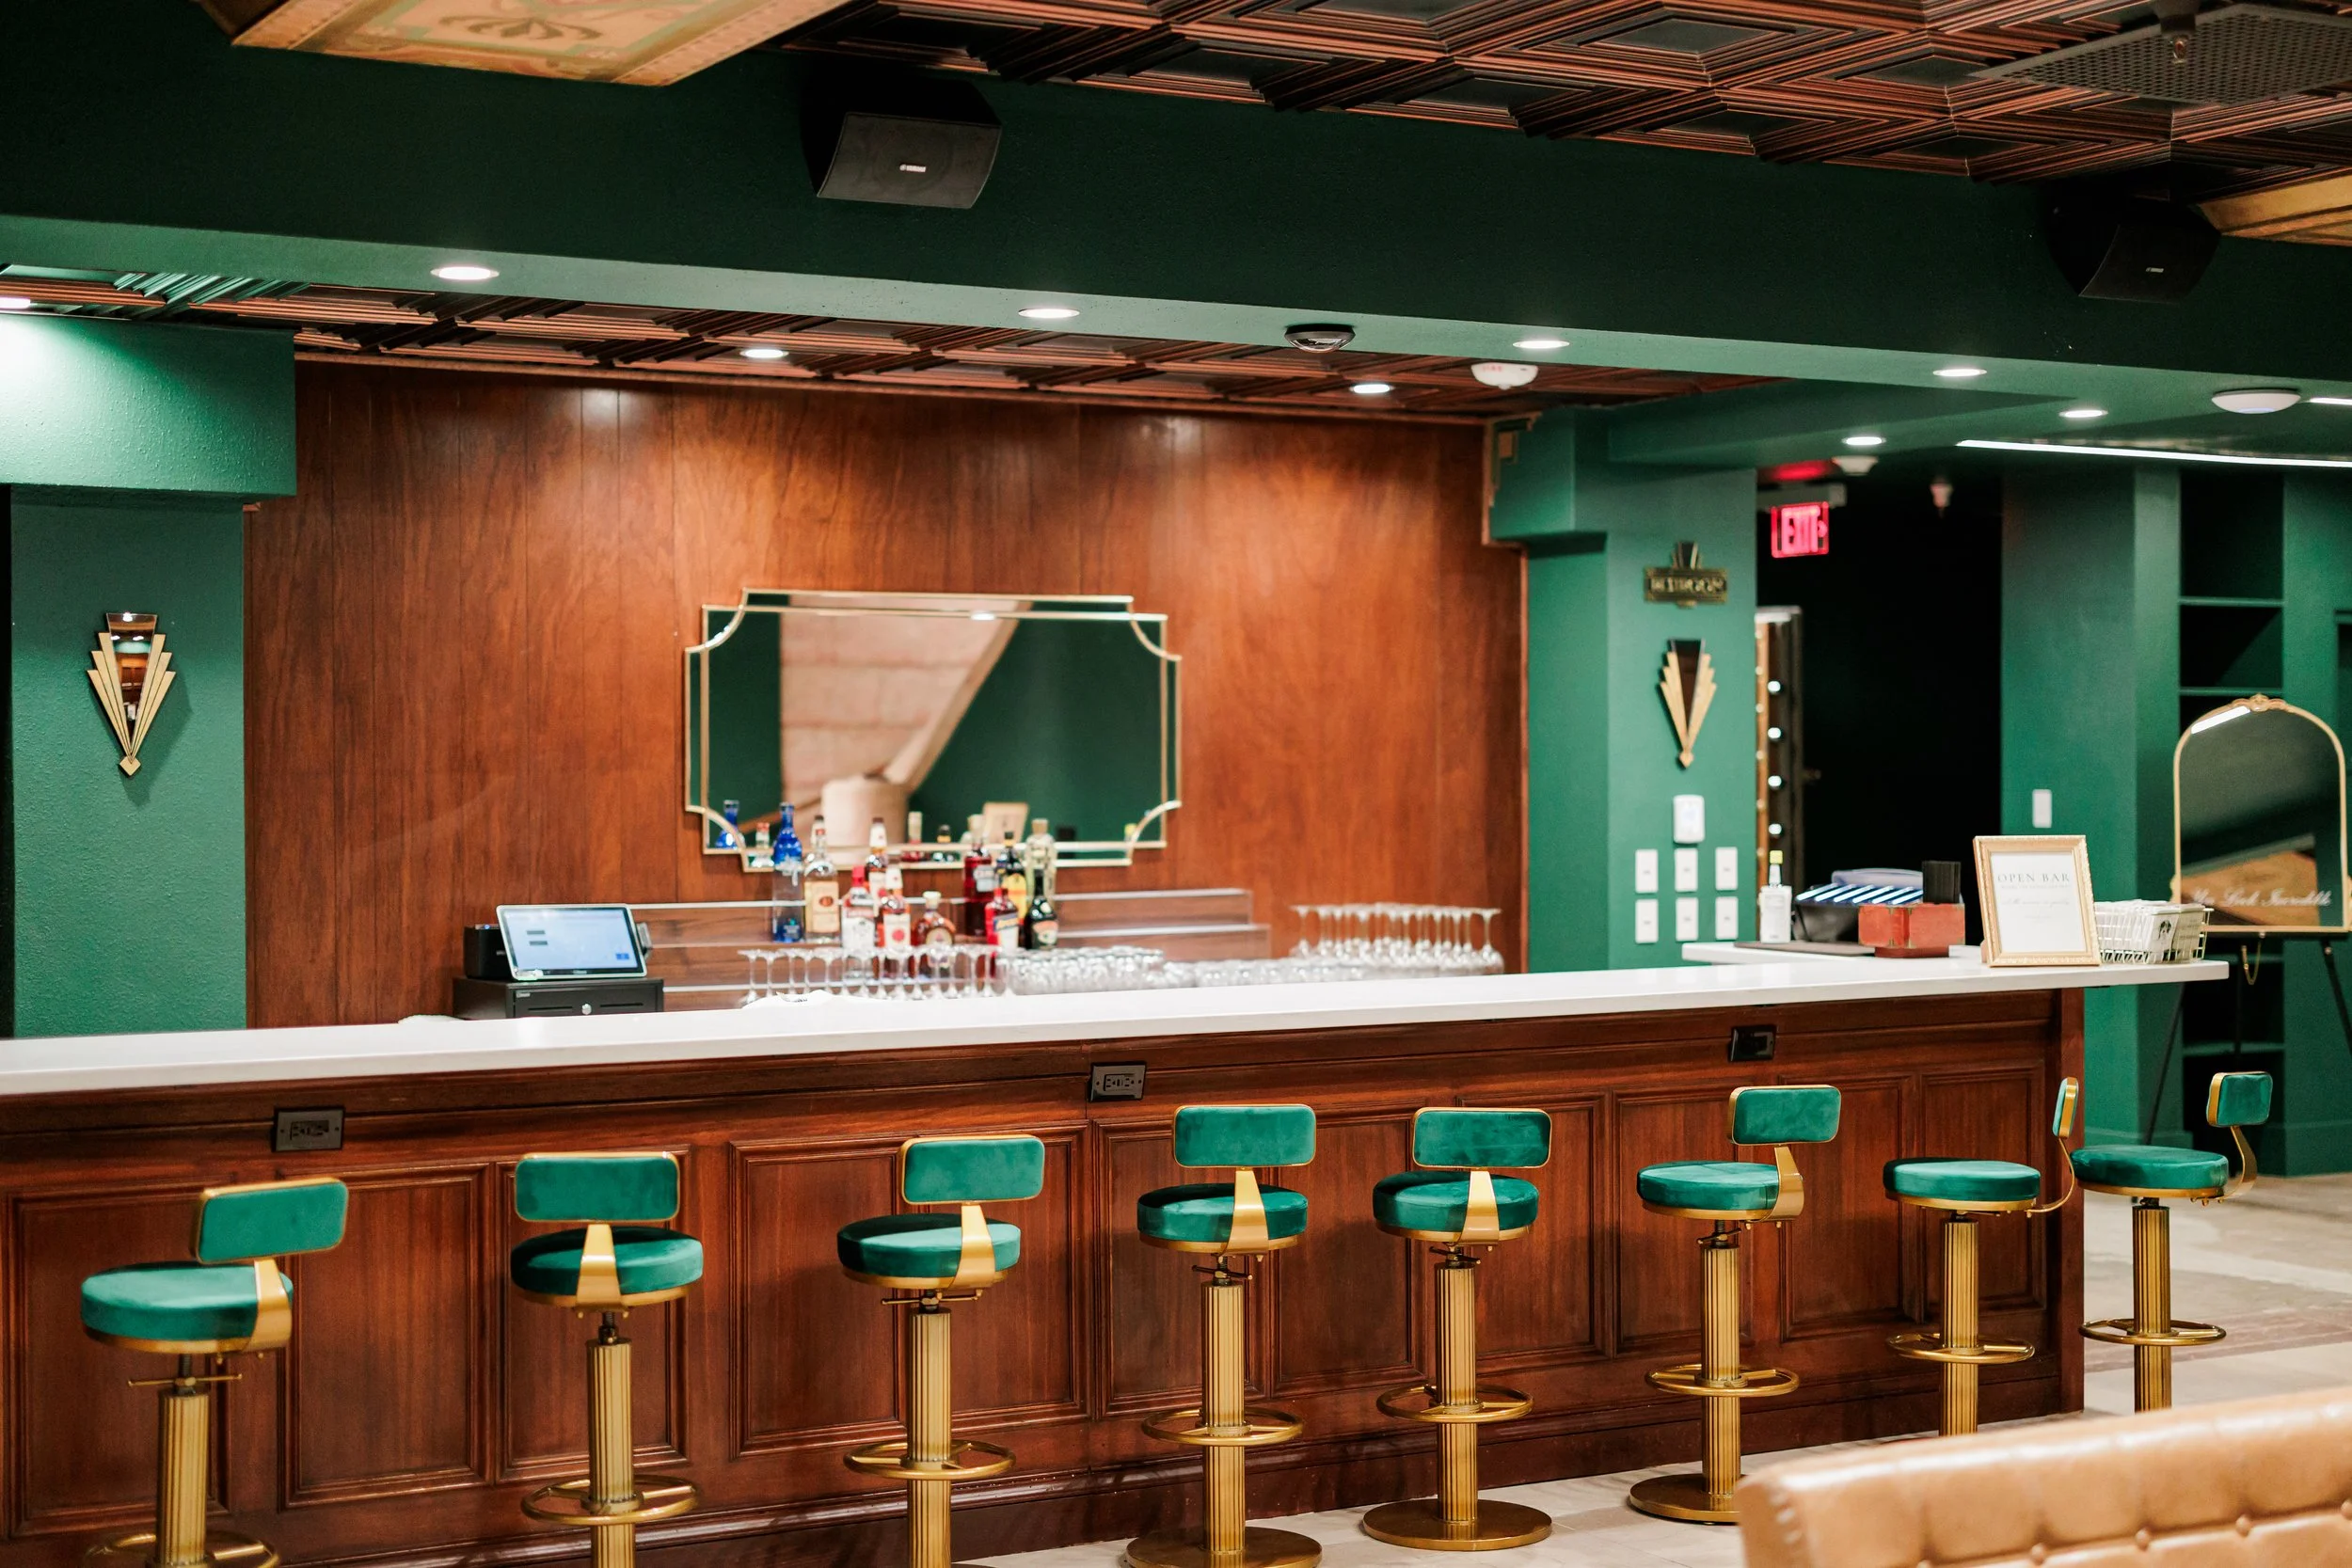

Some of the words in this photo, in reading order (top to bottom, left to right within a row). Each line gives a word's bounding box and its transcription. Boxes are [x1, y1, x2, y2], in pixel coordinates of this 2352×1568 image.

[1781, 506, 1820, 554] EXIT
[1997, 873, 2035, 882] OPEN
[2042, 873, 2070, 882] BAR
